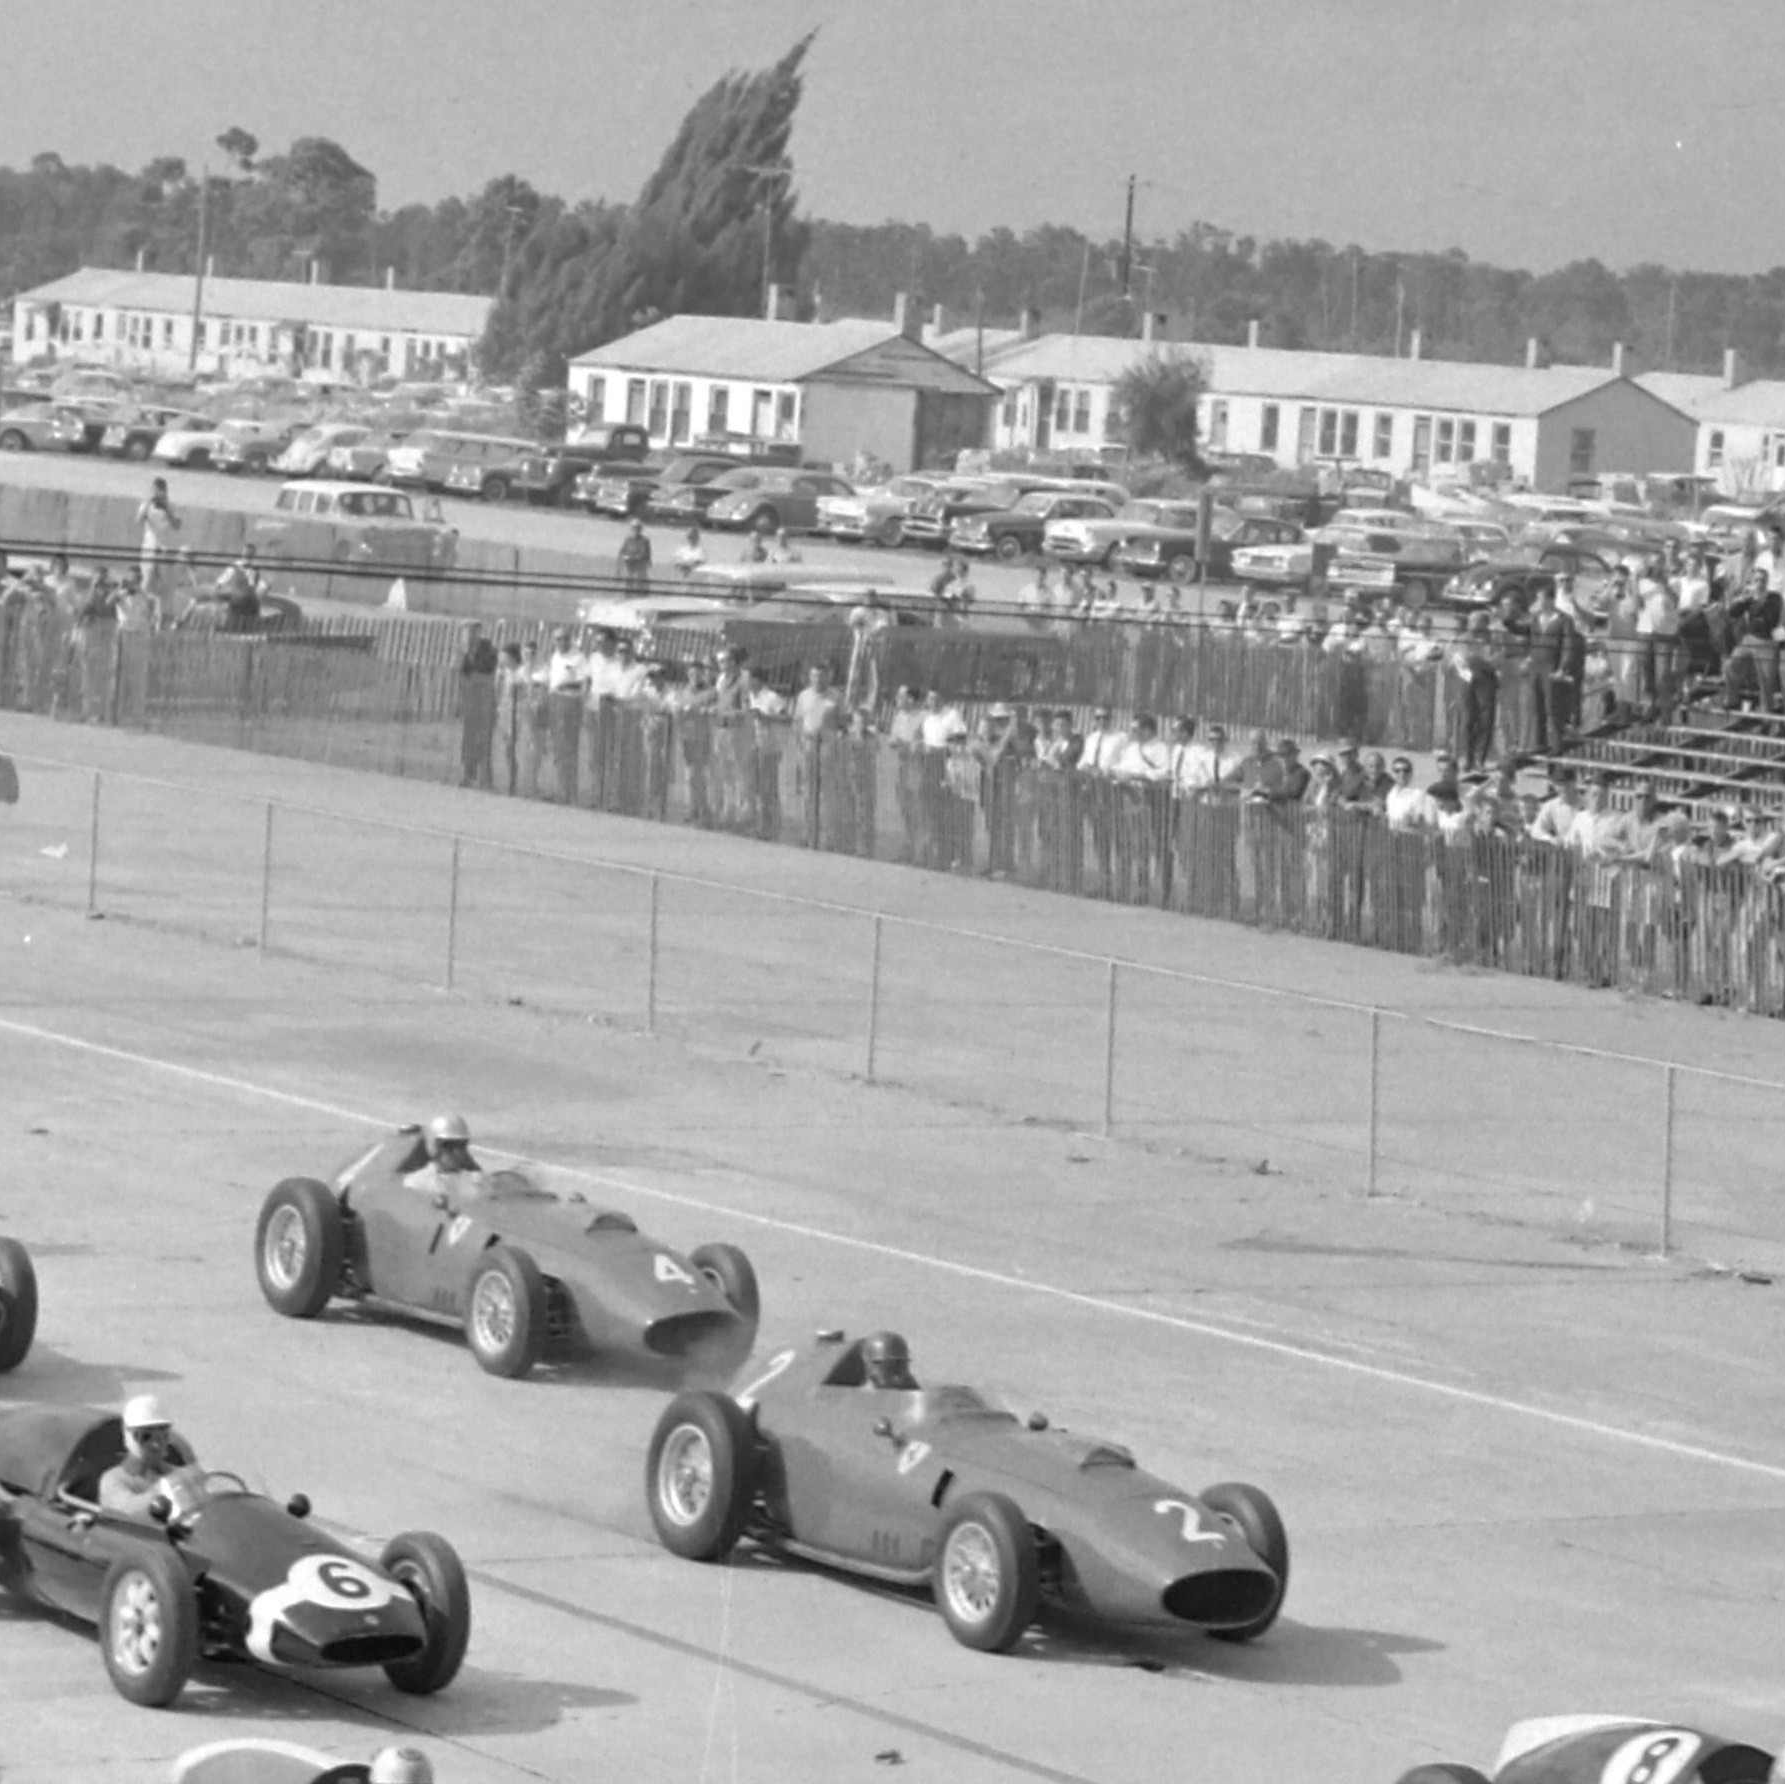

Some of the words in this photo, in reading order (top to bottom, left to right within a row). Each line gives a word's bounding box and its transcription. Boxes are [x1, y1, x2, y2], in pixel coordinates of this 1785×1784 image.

[654, 1254, 694, 1284] 4
[1154, 1500, 1226, 1542] 2
[318, 1562, 371, 1599] 6
